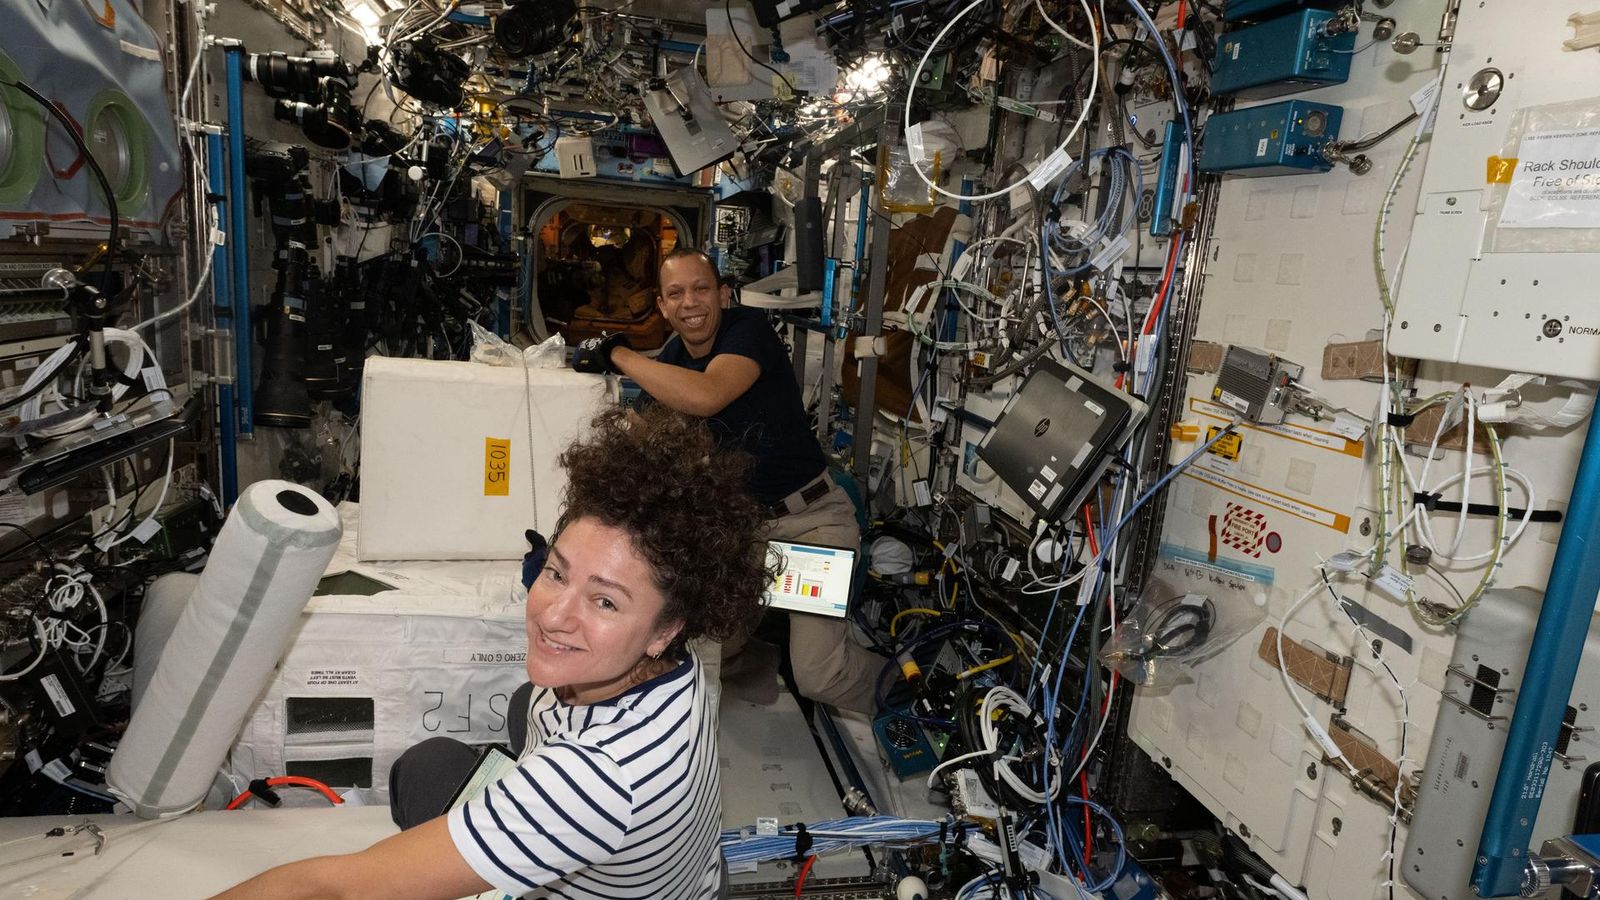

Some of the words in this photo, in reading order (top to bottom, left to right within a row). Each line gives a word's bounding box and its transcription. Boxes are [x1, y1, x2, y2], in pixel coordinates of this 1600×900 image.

[1523, 160, 1555, 173] Rack
[1533, 176, 1562, 187] Free
[1565, 174, 1580, 187] of
[1568, 325, 1600, 336] NORM
[488, 444, 507, 483] 1035
[1231, 522, 1242, 532] FIRE
[1241, 526, 1255, 536] PORT
[470, 652, 494, 663] ONLY
[496, 653, 503, 662] G
[504, 652, 527, 662] ZERO
